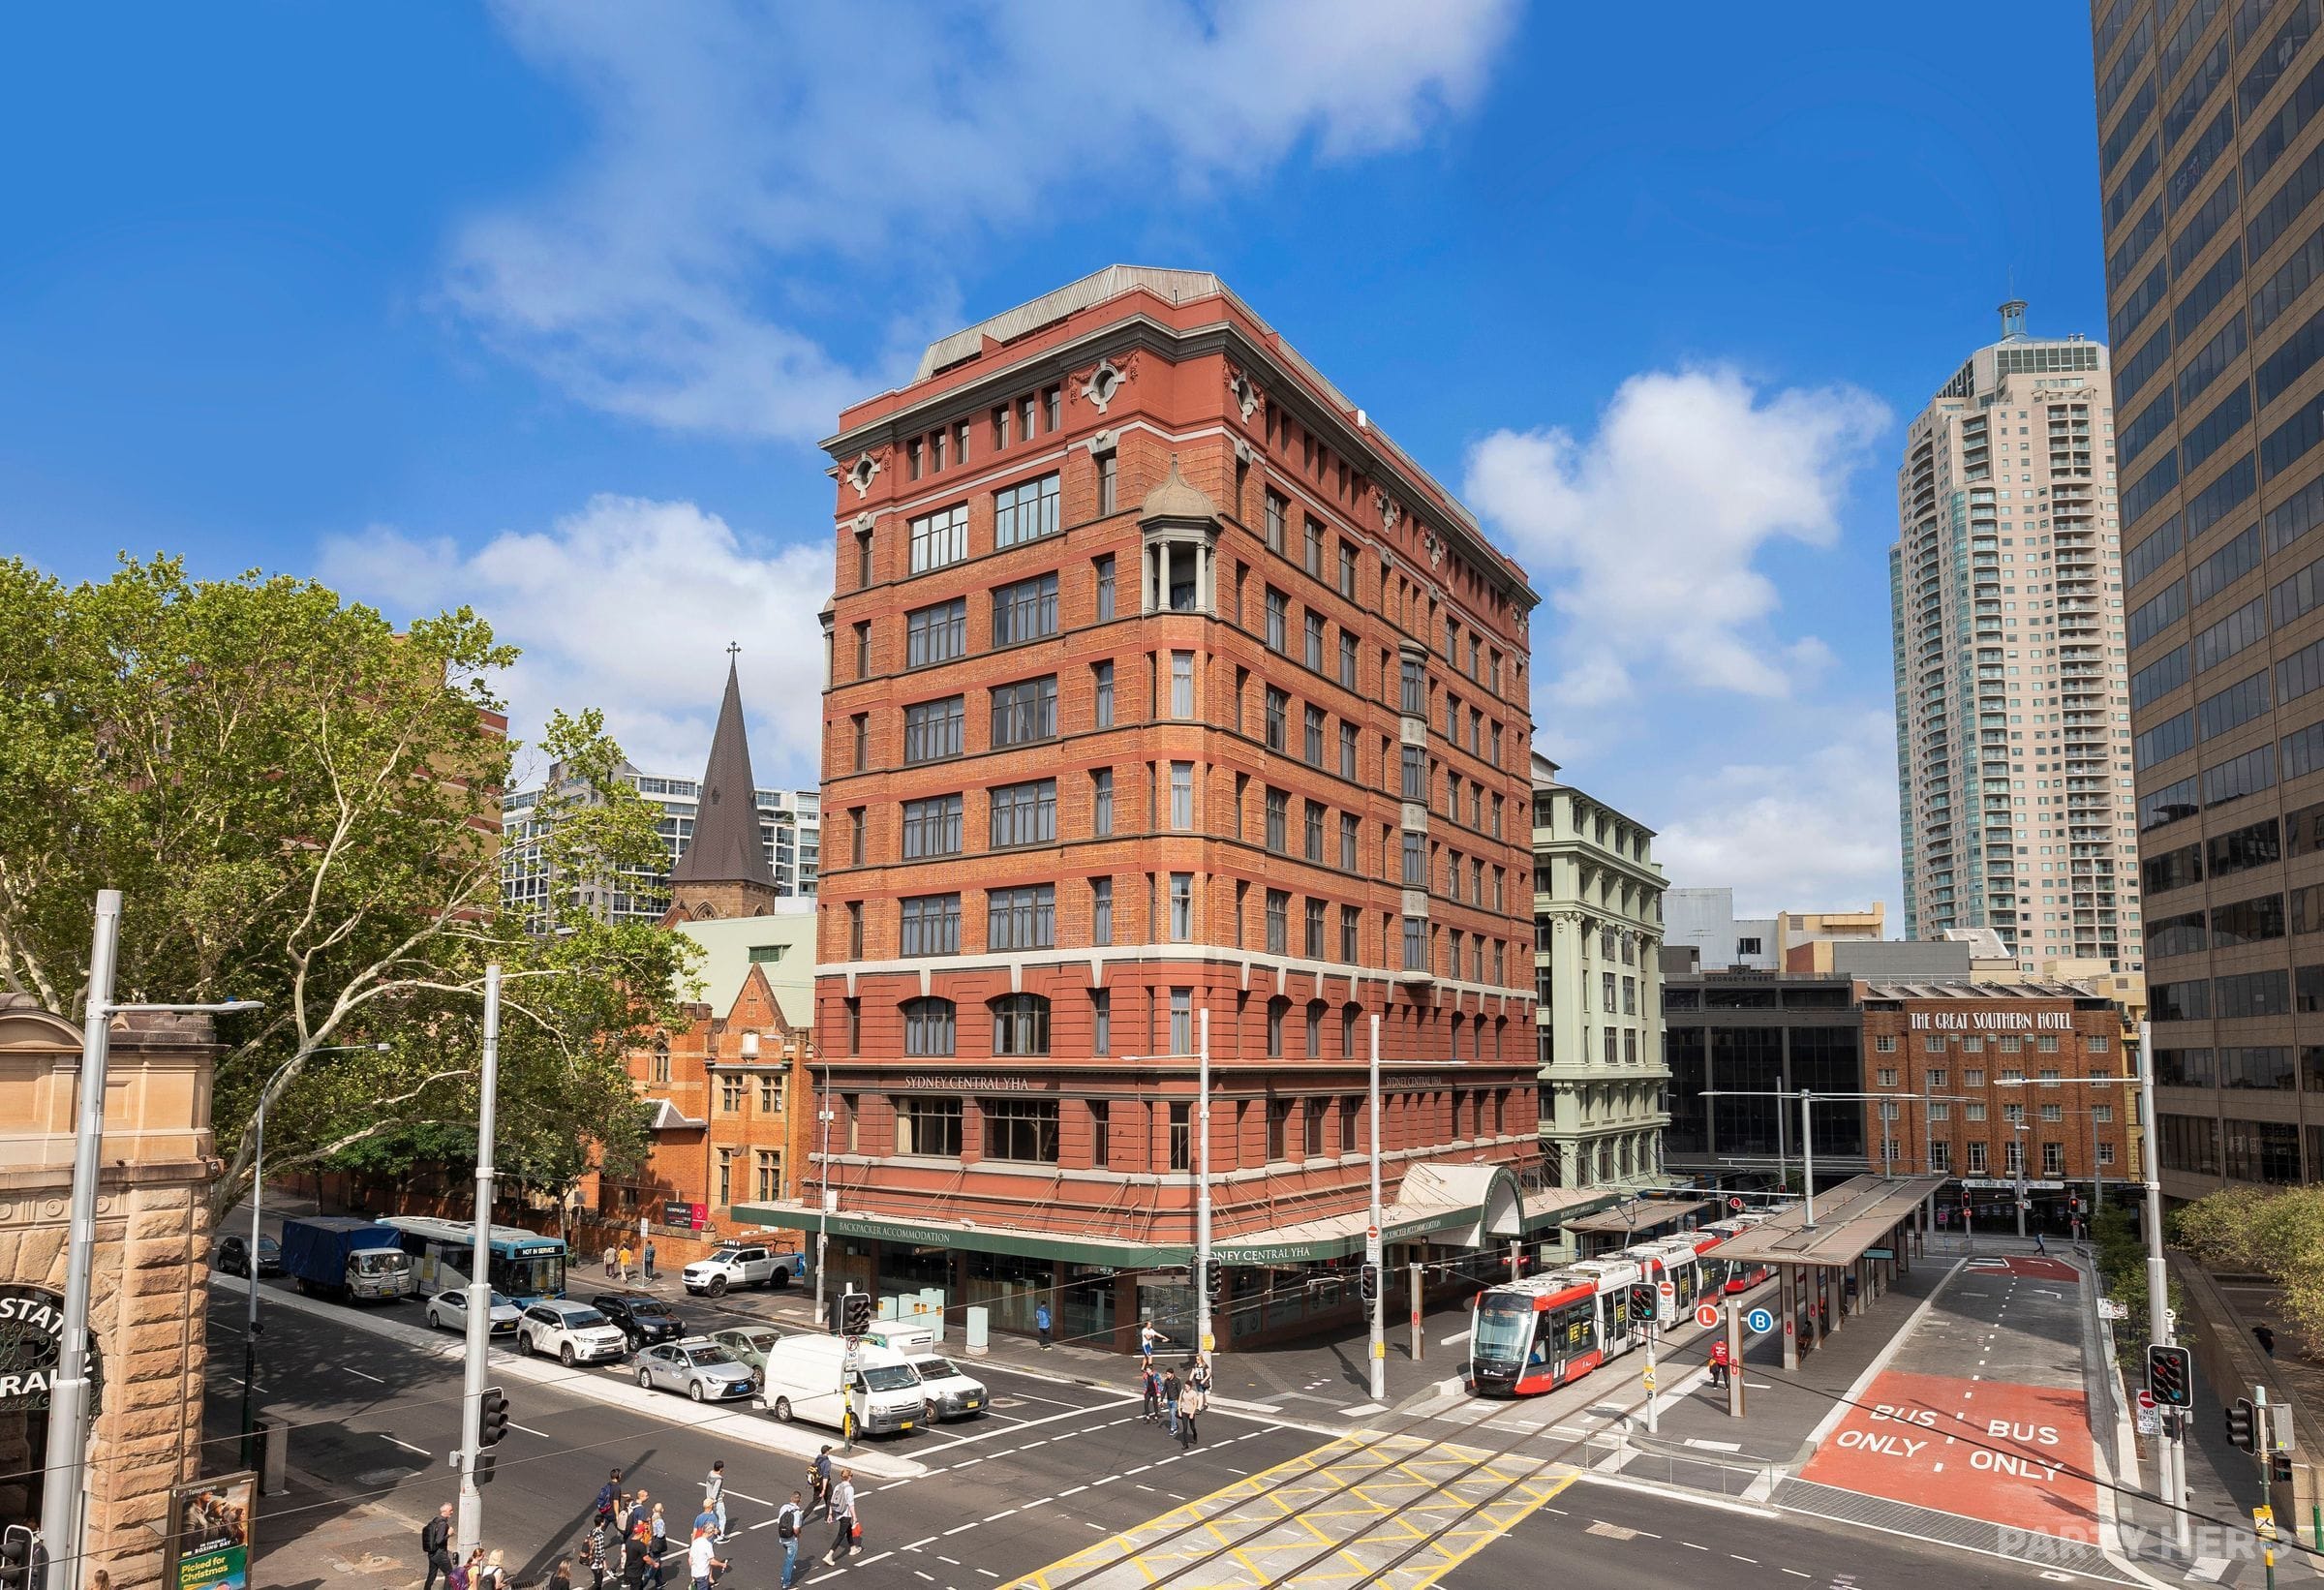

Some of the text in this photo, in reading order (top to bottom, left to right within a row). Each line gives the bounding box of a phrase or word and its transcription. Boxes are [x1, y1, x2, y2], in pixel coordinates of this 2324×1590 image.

[1911, 1012, 2073, 1029] THE GREAT SOUTHERN HOTEL
[905, 1076, 1029, 1090] SYDNEY CENTRAL YHA
[1386, 1076, 1407, 1088] SYDNEY
[1408, 1076, 1430, 1087] CENTRAL
[839, 1222, 950, 1242] BACKPACKER ACCOMMODATION
[1243, 1248, 1290, 1261] CENTRAL
[1291, 1246, 1310, 1257] YHA
[1869, 1404, 1939, 1426] BUS
[1987, 1420, 2060, 1445] BUS
[1836, 1430, 1929, 1458] ONLY
[1970, 1451, 2064, 1482] ONLY
[188, 1484, 218, 1496] Telephone
[181, 1557, 226, 1575] Picked for
[181, 1565, 229, 1582] Christmas
